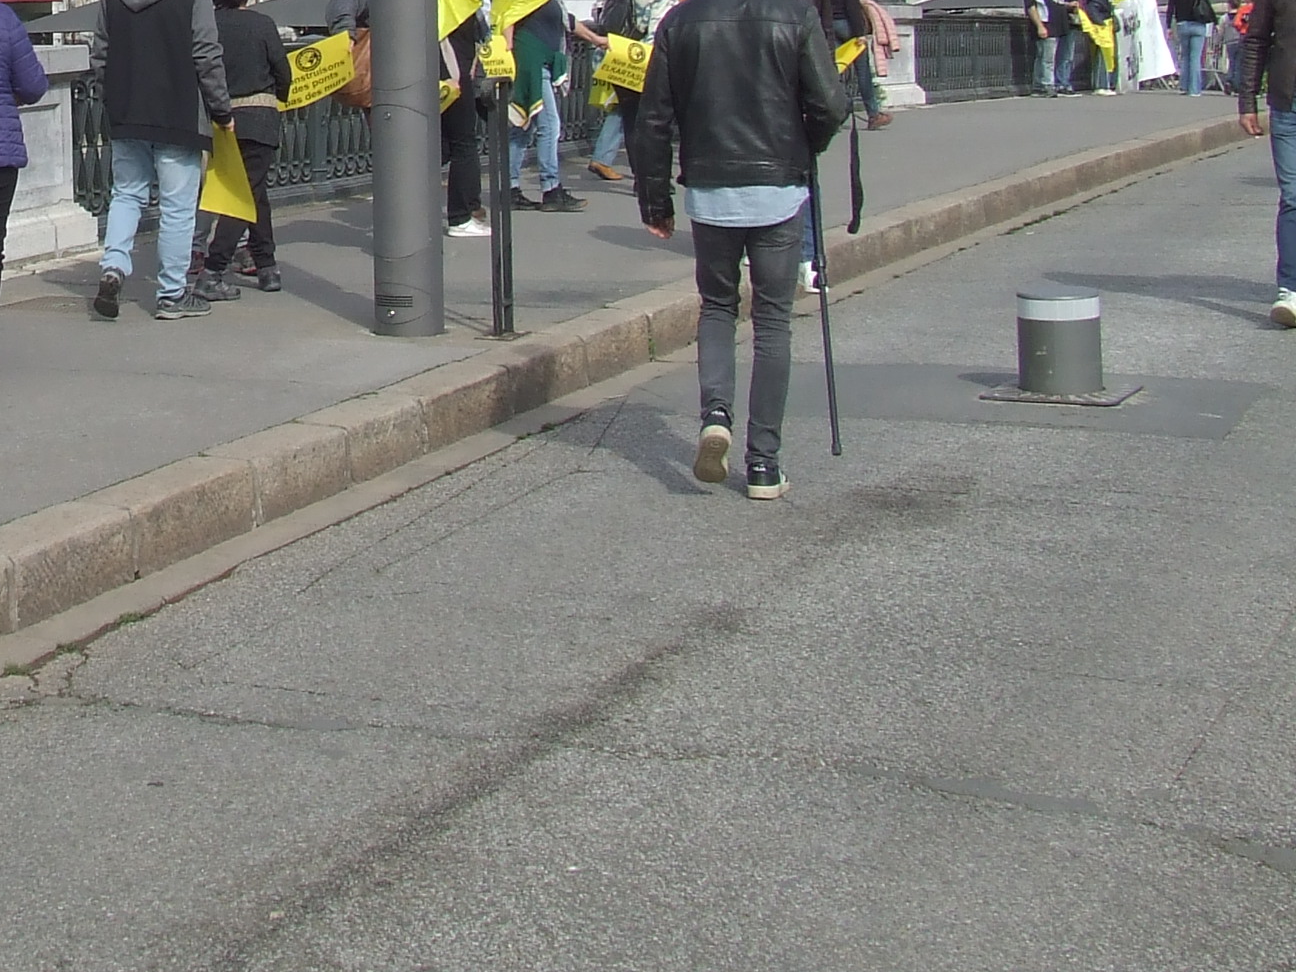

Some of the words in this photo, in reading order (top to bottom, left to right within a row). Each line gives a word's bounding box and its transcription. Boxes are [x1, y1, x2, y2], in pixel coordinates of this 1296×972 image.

[292, 60, 346, 85] nstruisons
[292, 83, 310, 95] des
[312, 71, 339, 89] ponts
[485, 67, 514, 76] TASUNA
[305, 88, 323, 101] des
[324, 76, 347, 93] murs
